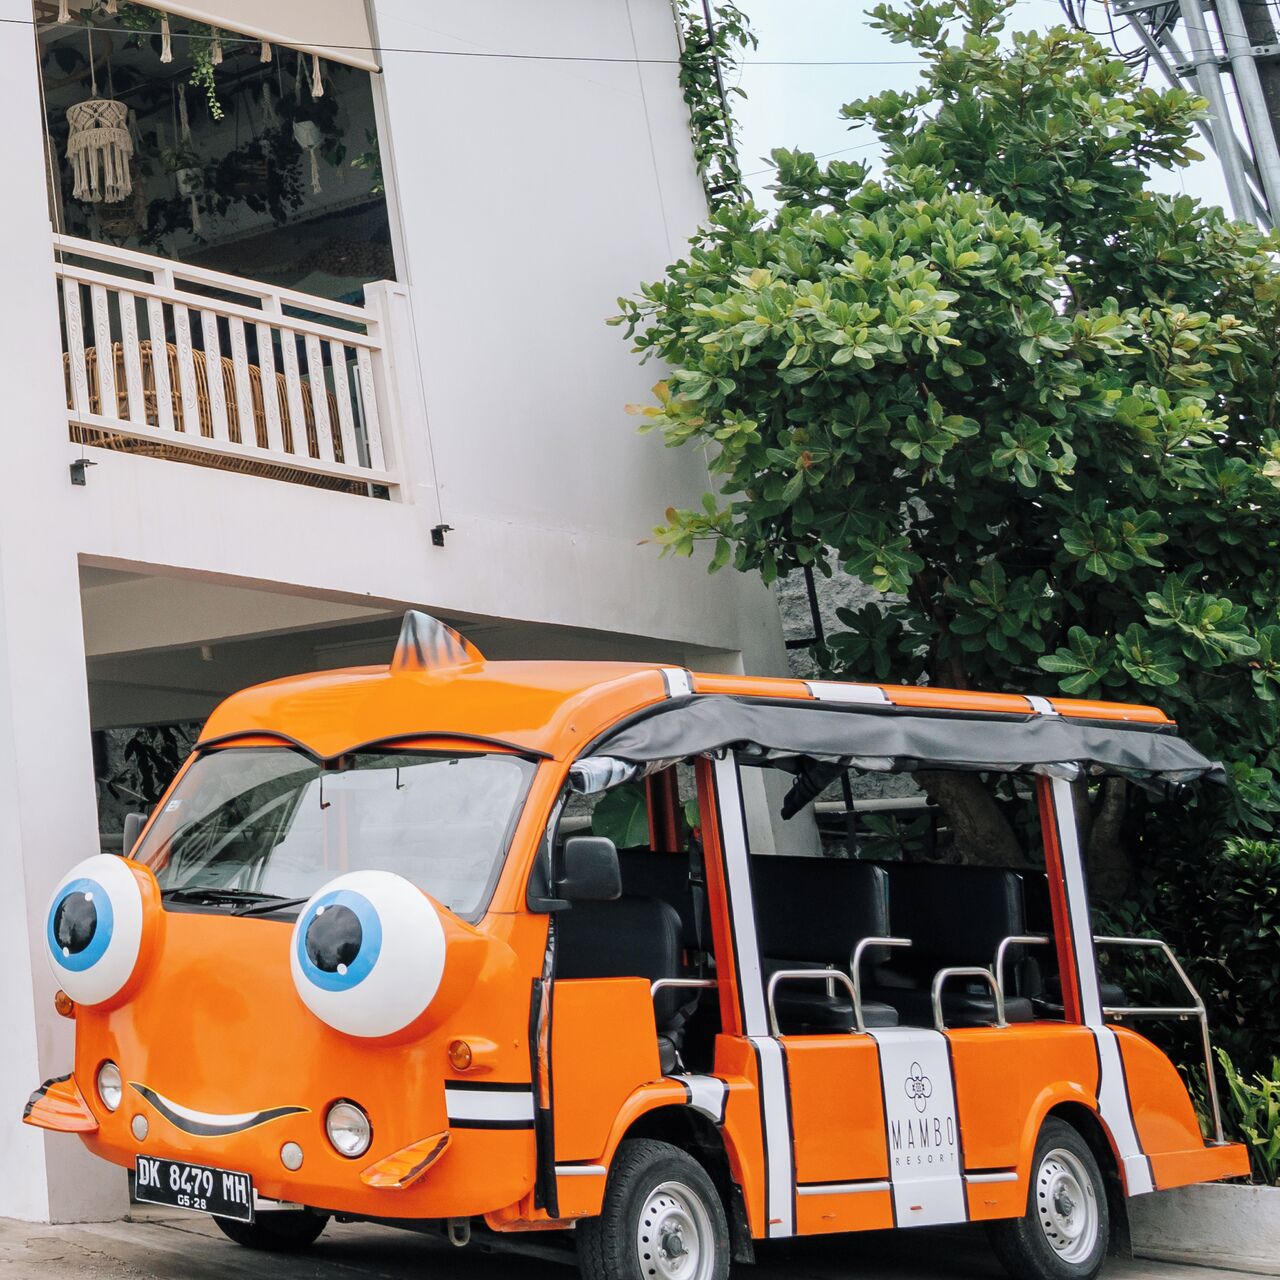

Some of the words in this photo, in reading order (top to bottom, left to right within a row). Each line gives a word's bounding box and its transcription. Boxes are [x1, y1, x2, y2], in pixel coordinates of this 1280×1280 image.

[891, 1117, 954, 1150] MAMBO
[895, 1154, 954, 1166] RESORT
[138, 1158, 160, 1188] DK
[169, 1165, 214, 1197] 8479
[222, 1173, 247, 1204] MH
